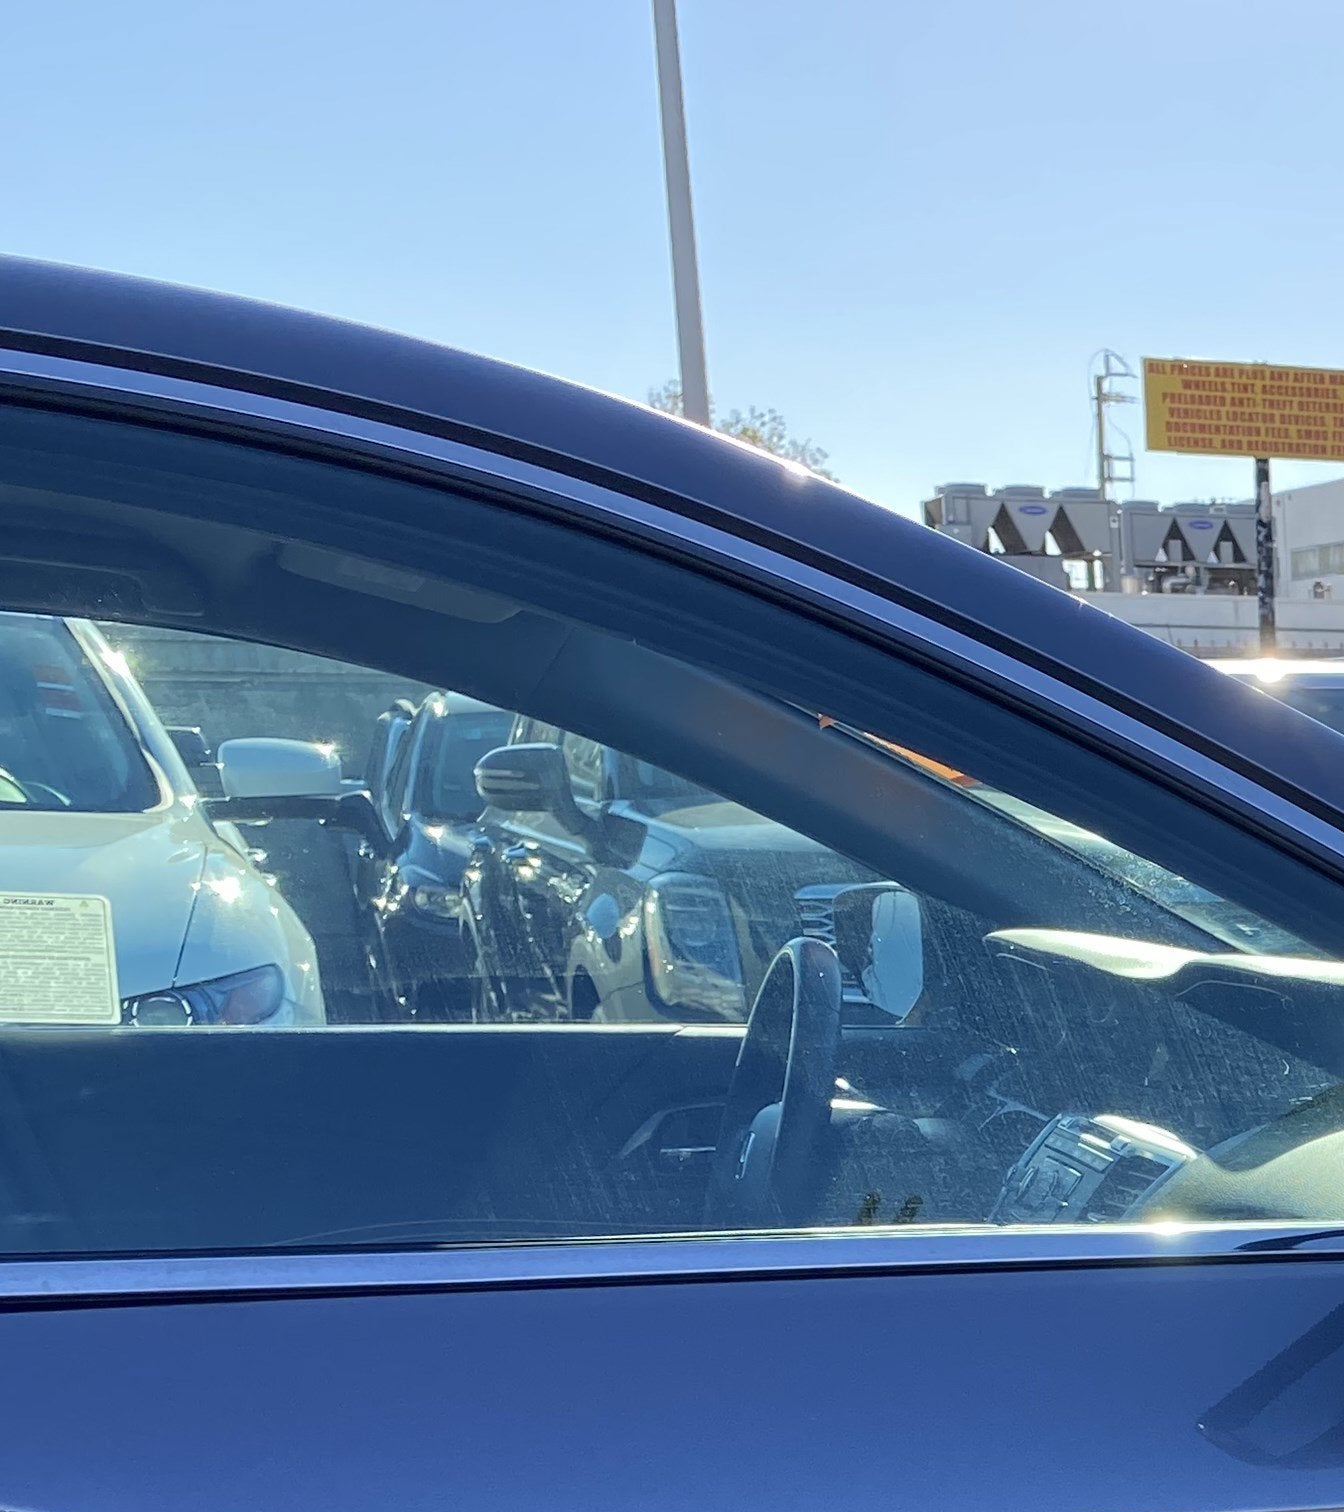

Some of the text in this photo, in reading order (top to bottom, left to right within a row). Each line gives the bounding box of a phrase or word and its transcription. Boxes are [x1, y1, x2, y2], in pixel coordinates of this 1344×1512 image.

[1147, 362, 1167, 376] ALL
[1170, 364, 1211, 378] PRICES
[1214, 366, 1235, 380] ARE
[1239, 368, 1266, 381] PLUS
[1269, 370, 1290, 383] ANY
[1293, 371, 1325, 384] AFTER
[1296, 429, 1329, 441] SMOG
